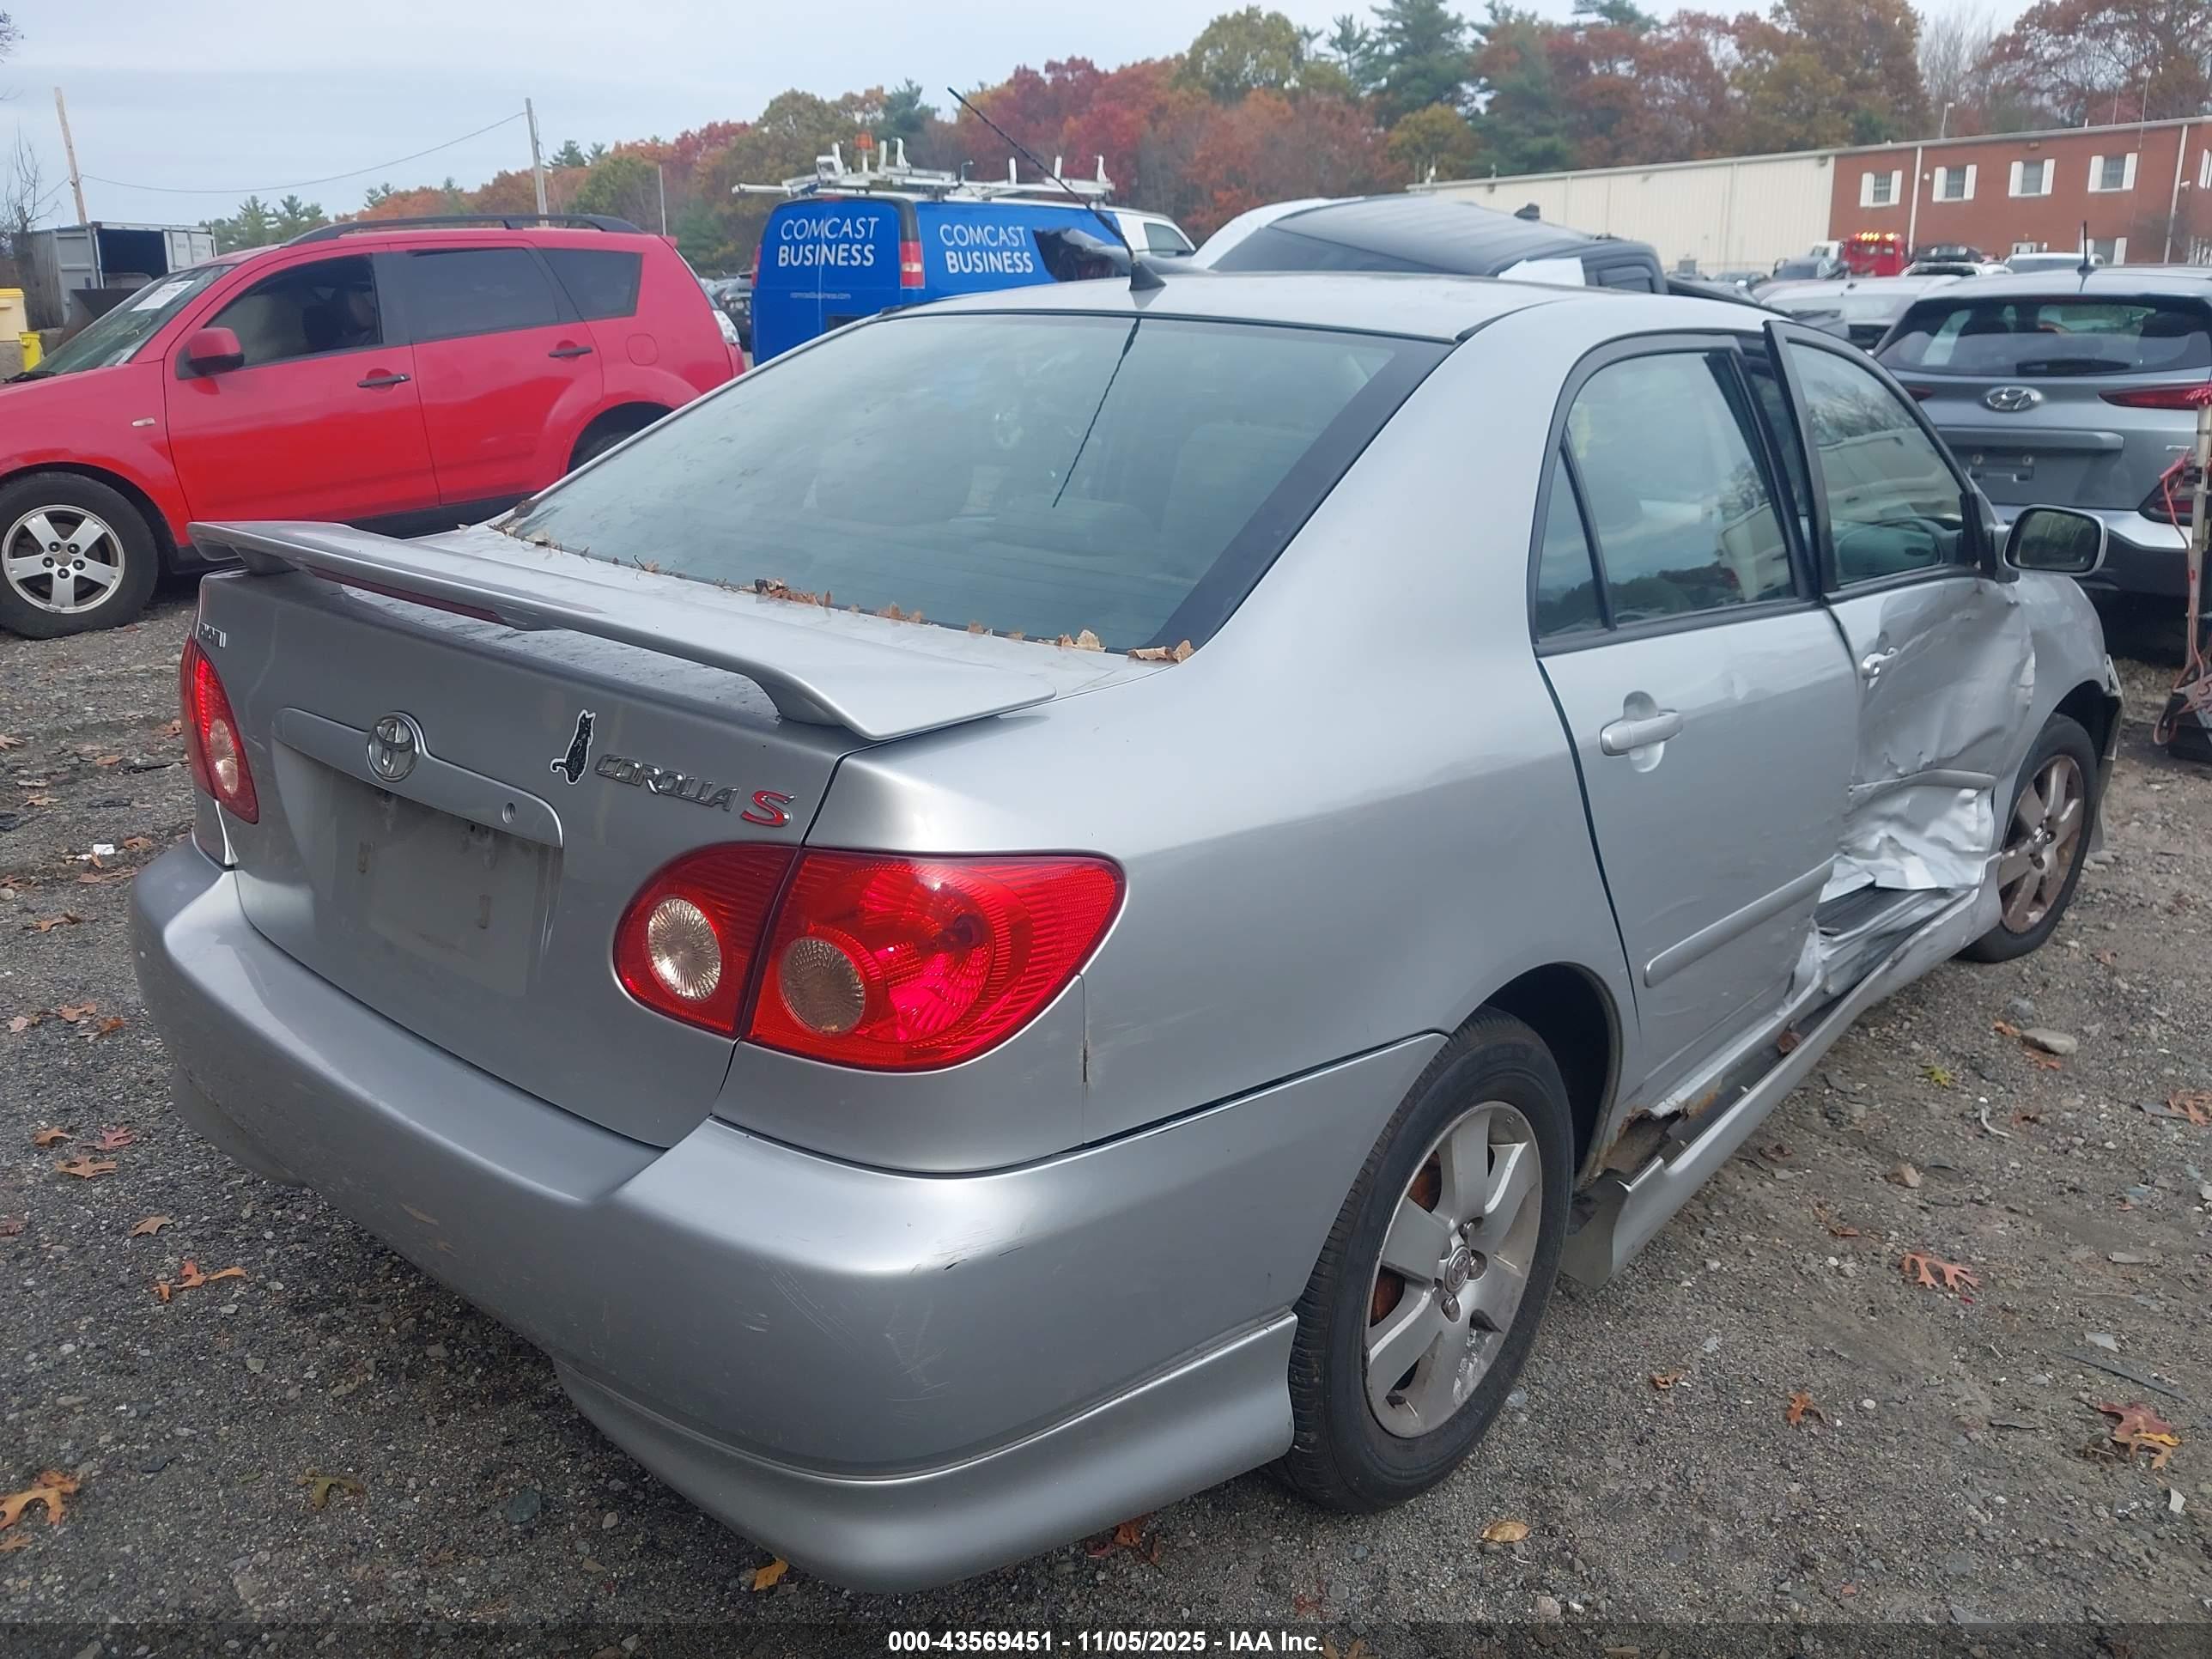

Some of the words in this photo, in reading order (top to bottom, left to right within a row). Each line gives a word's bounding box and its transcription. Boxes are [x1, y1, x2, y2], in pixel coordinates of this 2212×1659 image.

[781, 216, 880, 240] COMCAST
[939, 223, 1026, 247] COMCAST
[778, 243, 875, 267] BUSINESS
[945, 250, 1034, 274] BUSINESS
[594, 753, 739, 811] COROLLA
[740, 790, 799, 828] S
